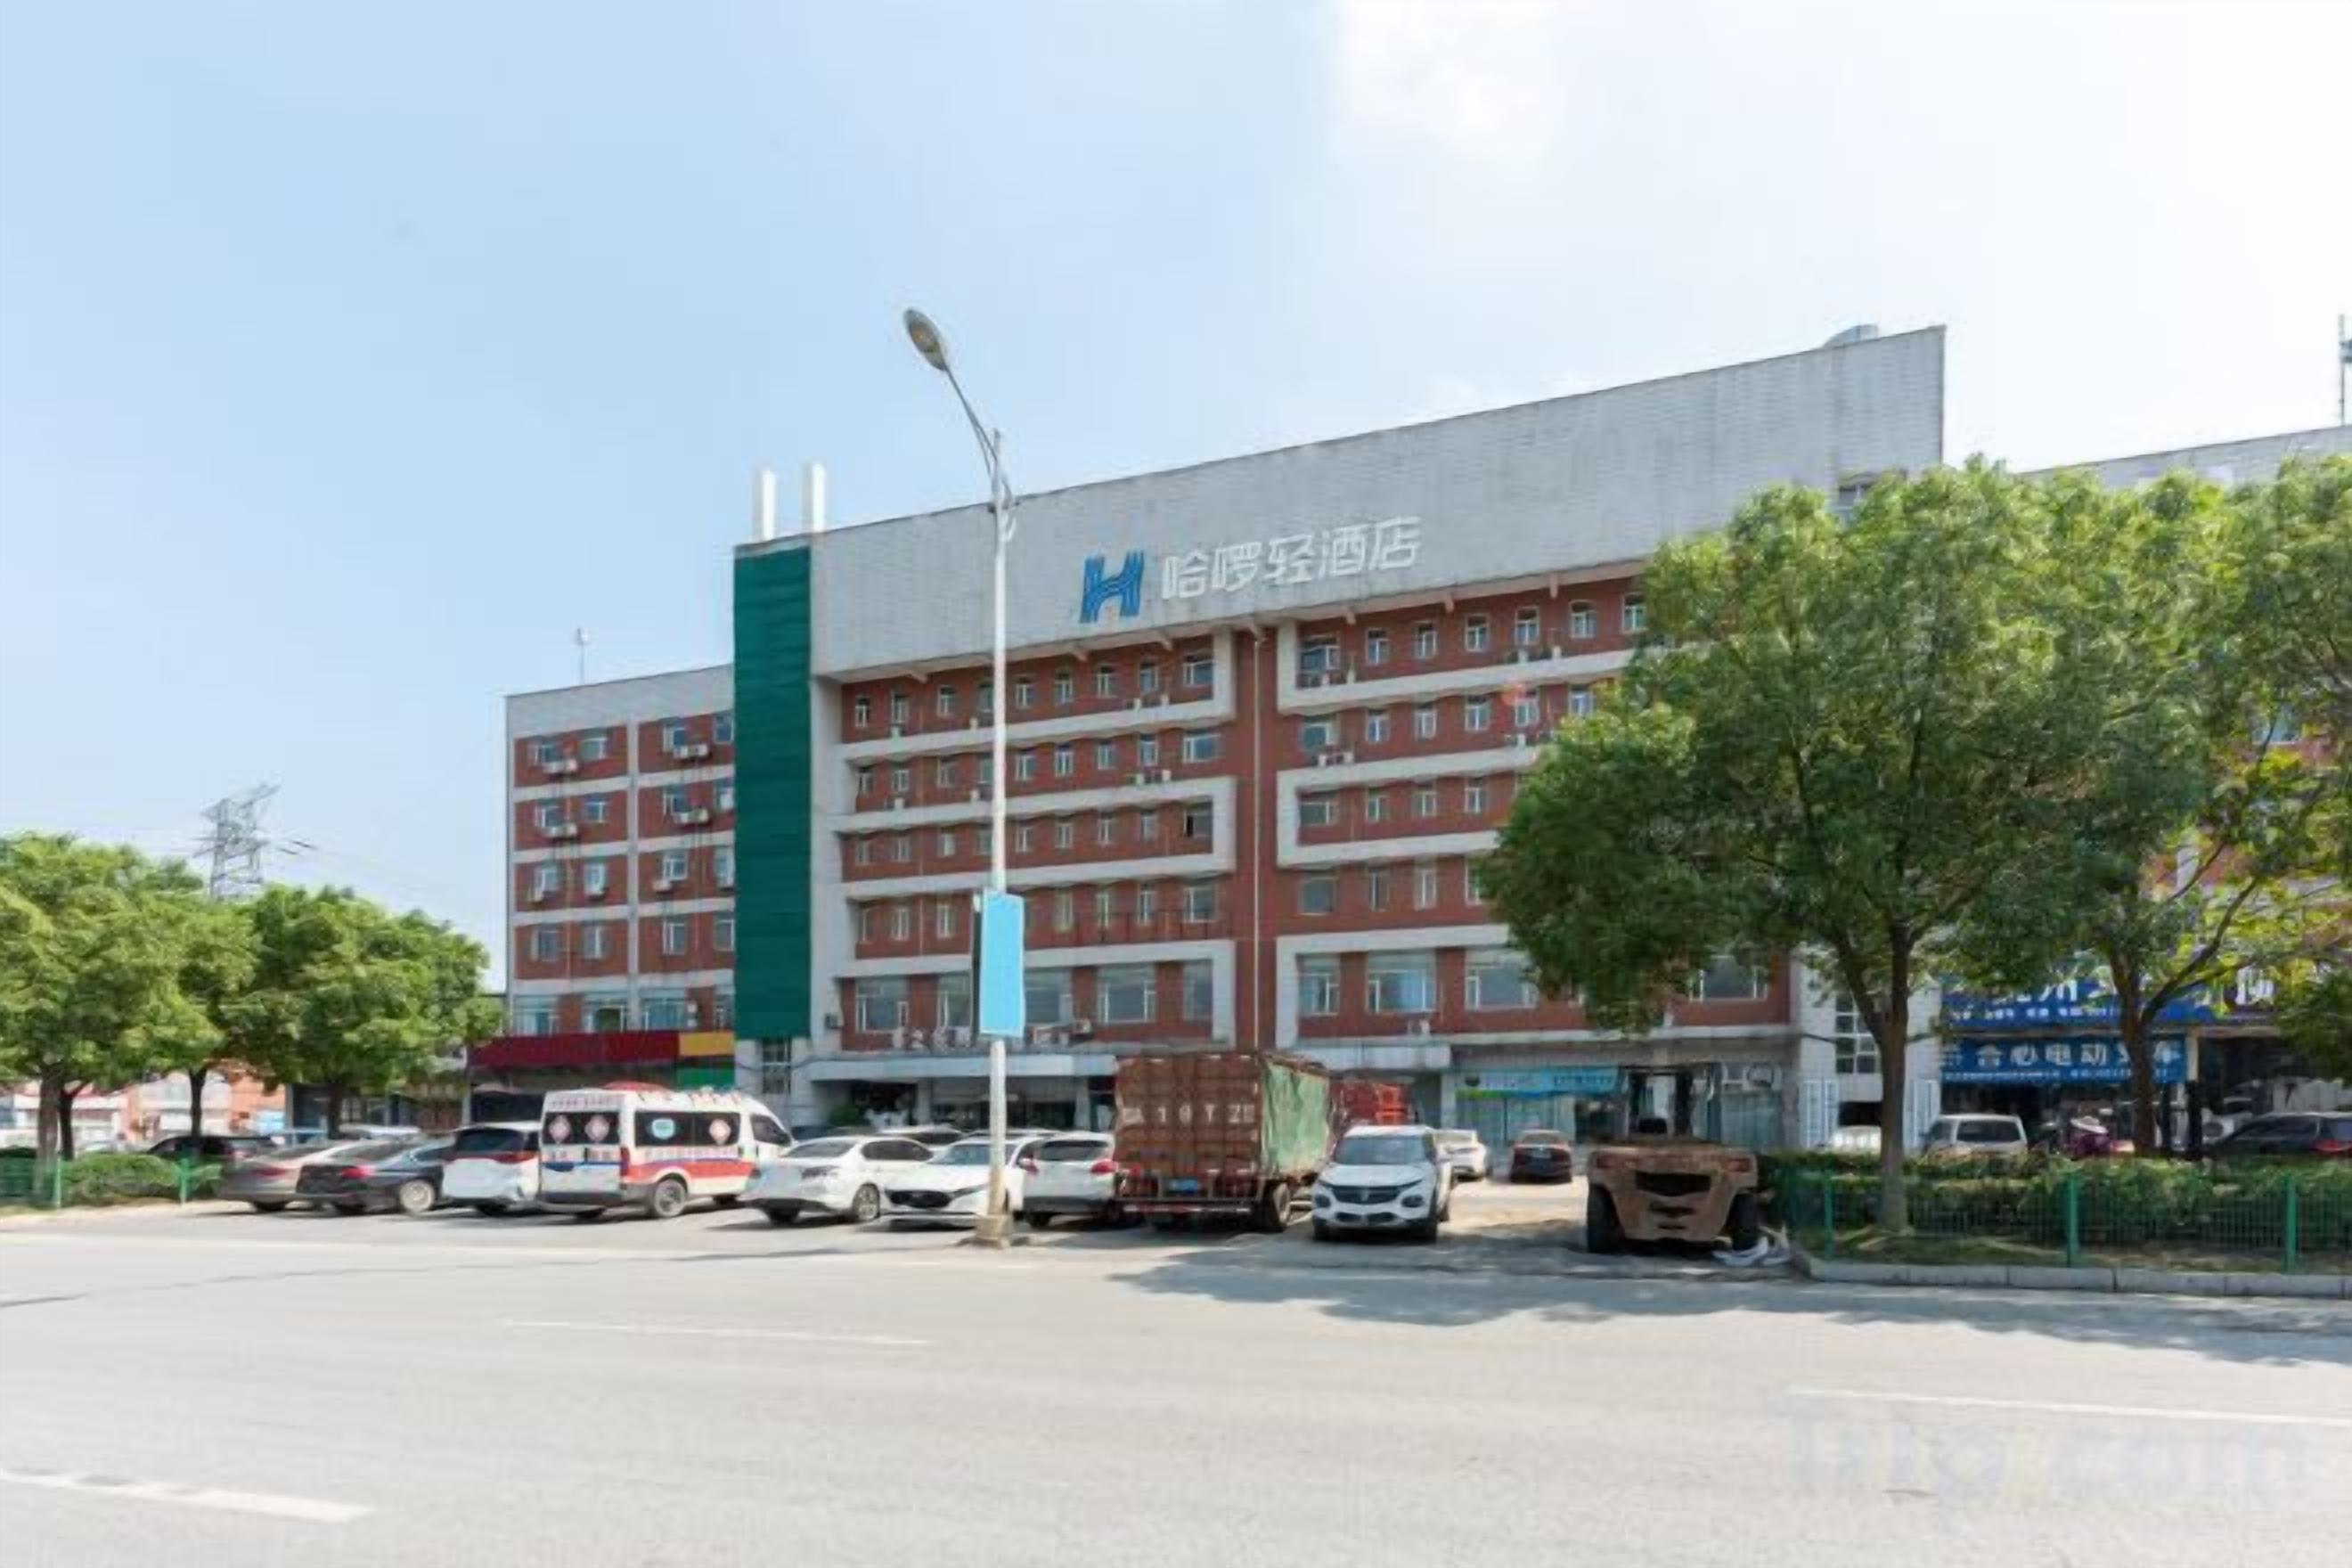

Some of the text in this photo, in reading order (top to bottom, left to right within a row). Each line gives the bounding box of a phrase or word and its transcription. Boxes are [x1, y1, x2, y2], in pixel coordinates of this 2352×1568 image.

[1161, 515, 1423, 601] 哈啰轻酒店
